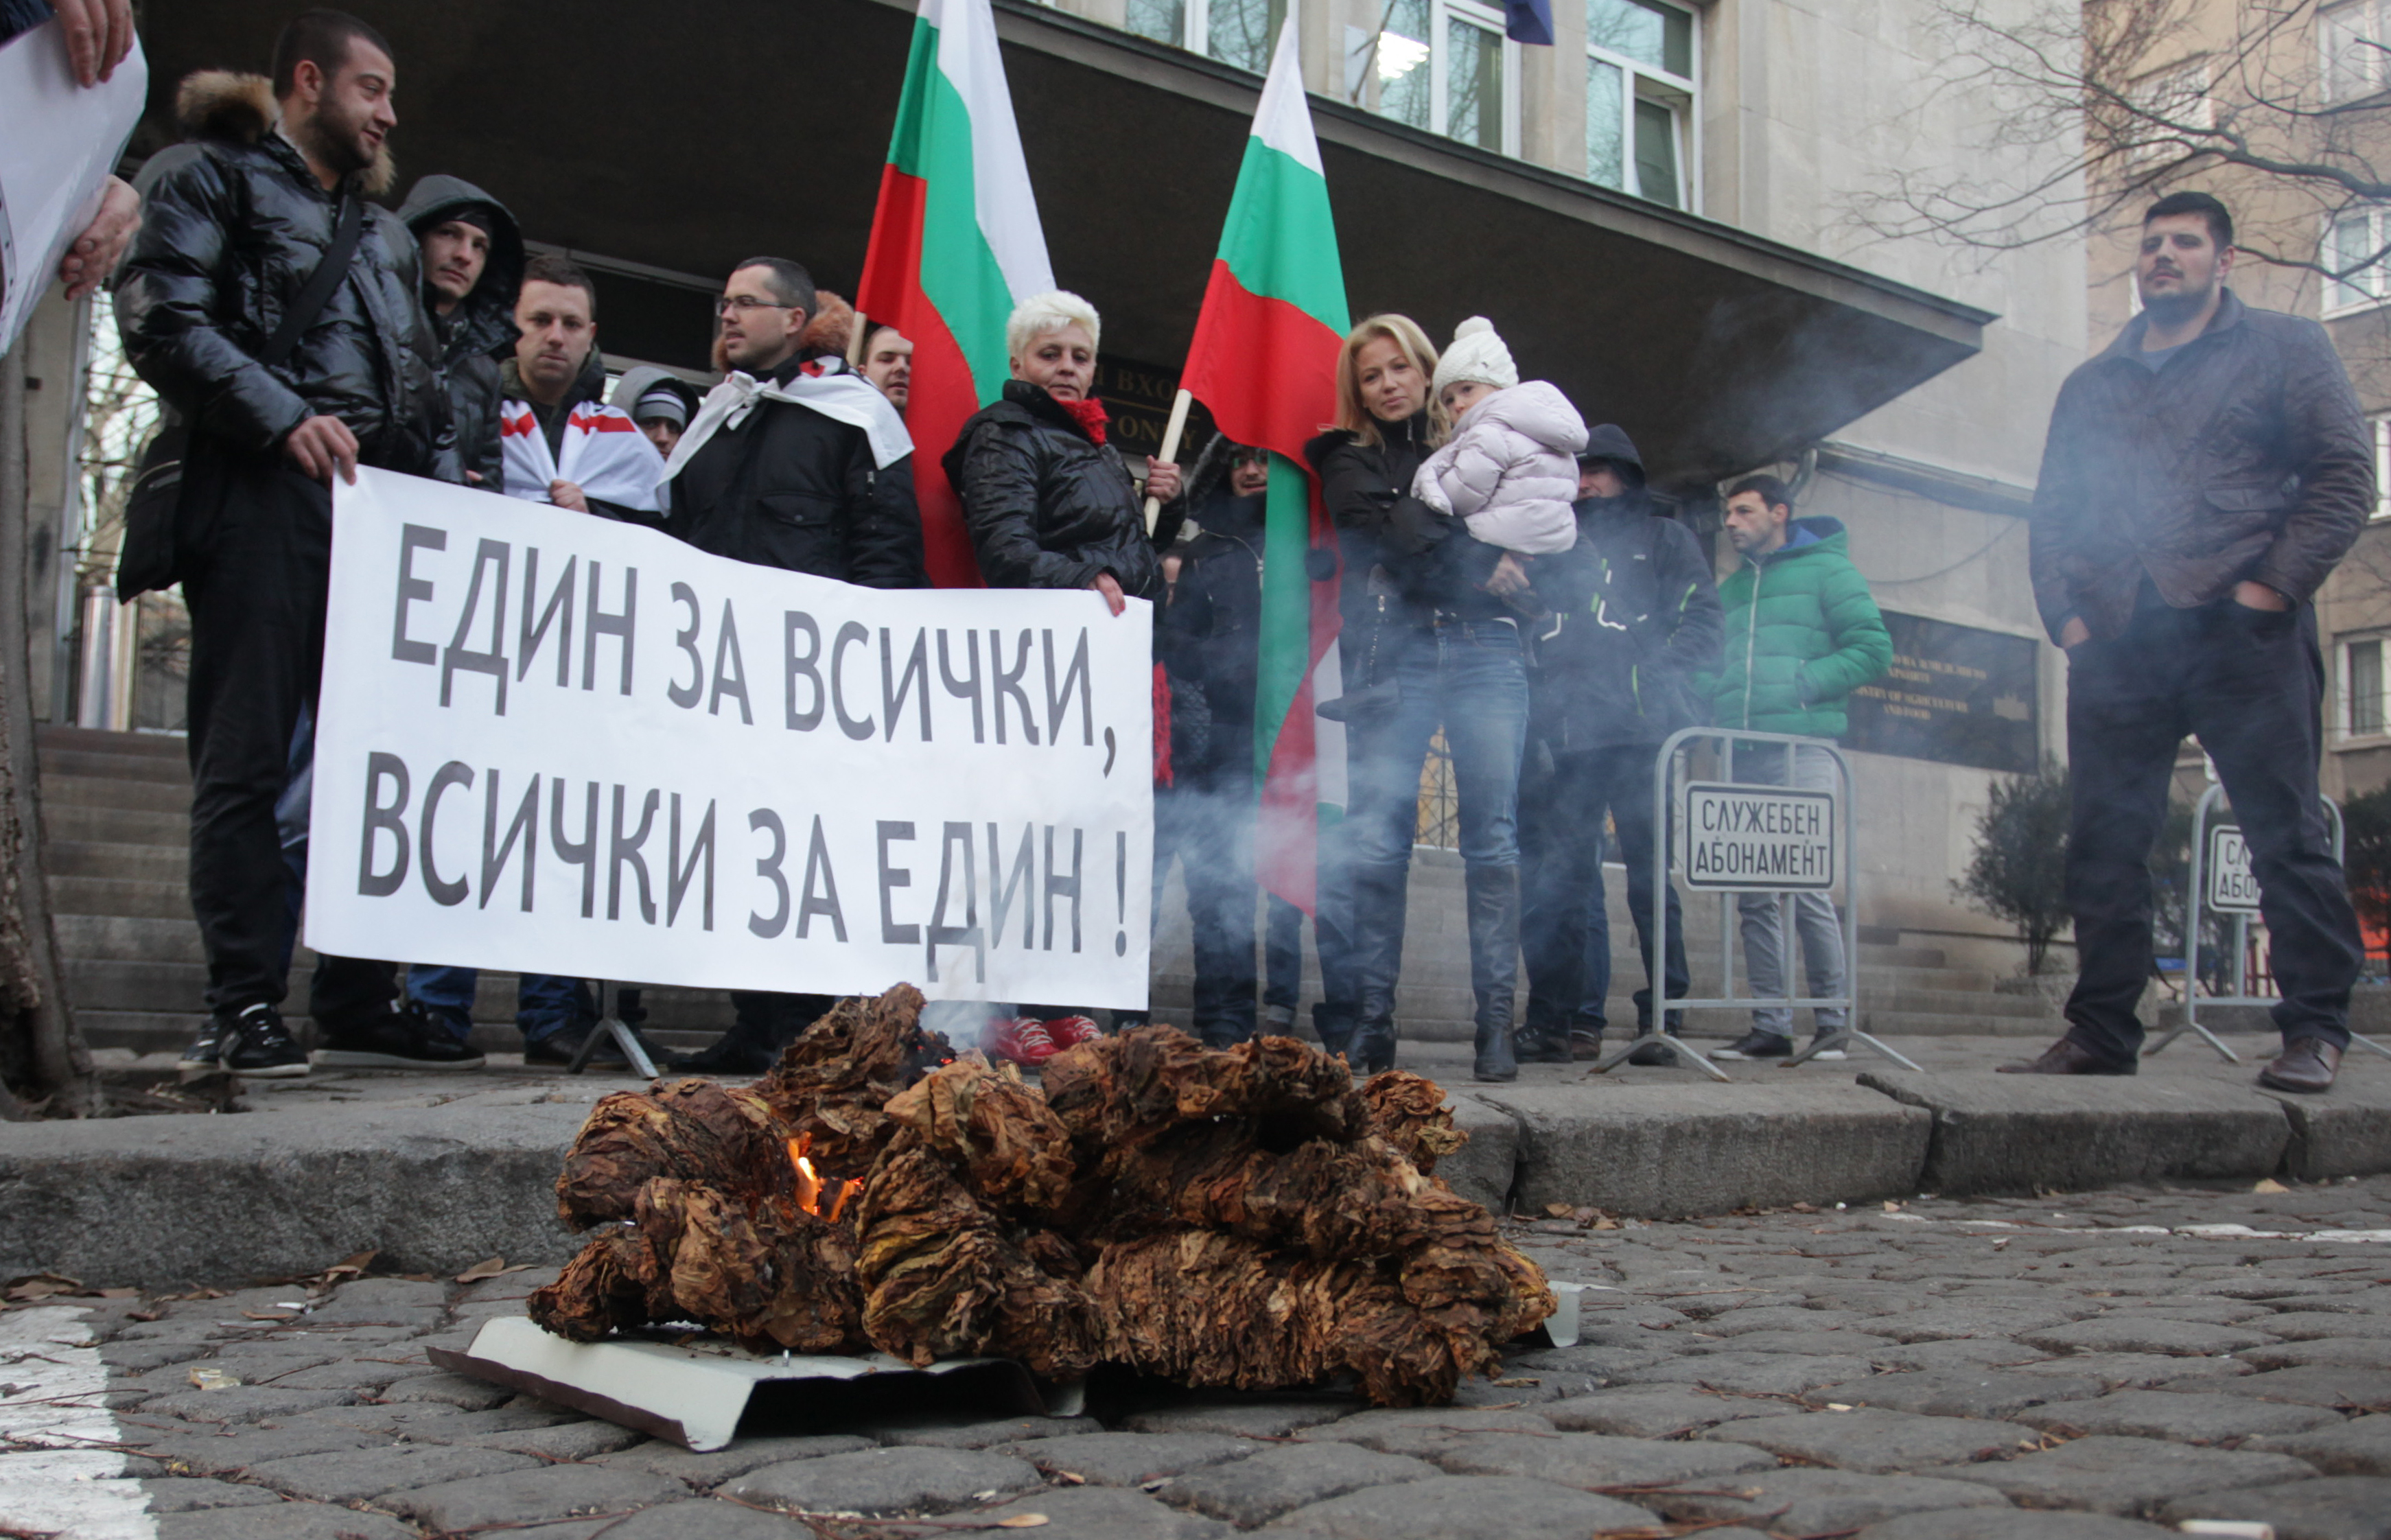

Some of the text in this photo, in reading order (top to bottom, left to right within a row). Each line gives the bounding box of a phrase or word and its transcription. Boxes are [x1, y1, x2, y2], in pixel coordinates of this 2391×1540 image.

[1117, 369, 1175, 401] ВХО
[1118, 415, 1196, 450] ONY
[393, 524, 1117, 778] ЕДИН ЗА ВСИЧКИ,
[1703, 799, 1819, 835] СЛУЖЕБЕН
[358, 751, 714, 931] ВСИЧКИ
[749, 808, 848, 942] ЗА
[878, 821, 1082, 983] ЕДИН
[1695, 841, 1827, 876] АБОНАМЕНТ
